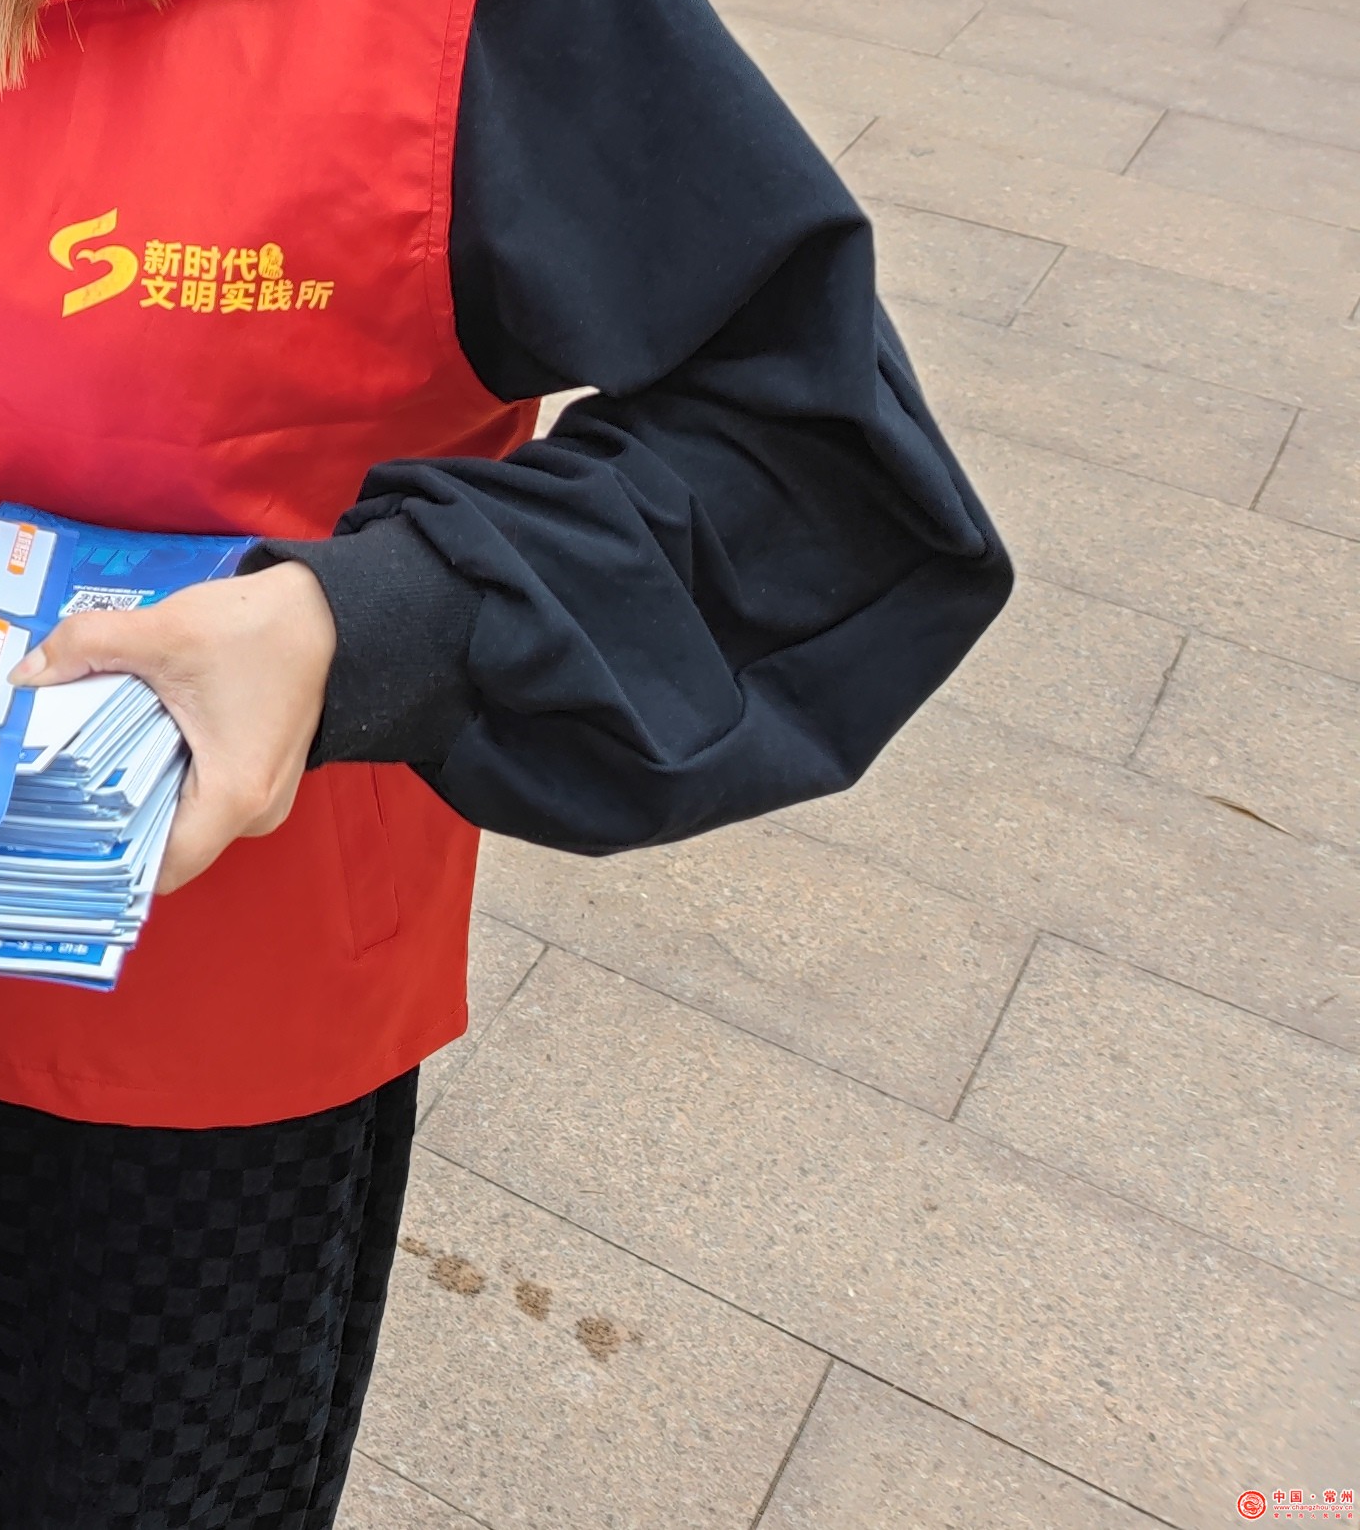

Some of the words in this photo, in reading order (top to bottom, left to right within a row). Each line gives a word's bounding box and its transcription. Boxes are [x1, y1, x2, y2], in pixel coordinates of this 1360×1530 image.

[143, 238, 258, 283] 新时代
[138, 275, 335, 315] 文明实践所
